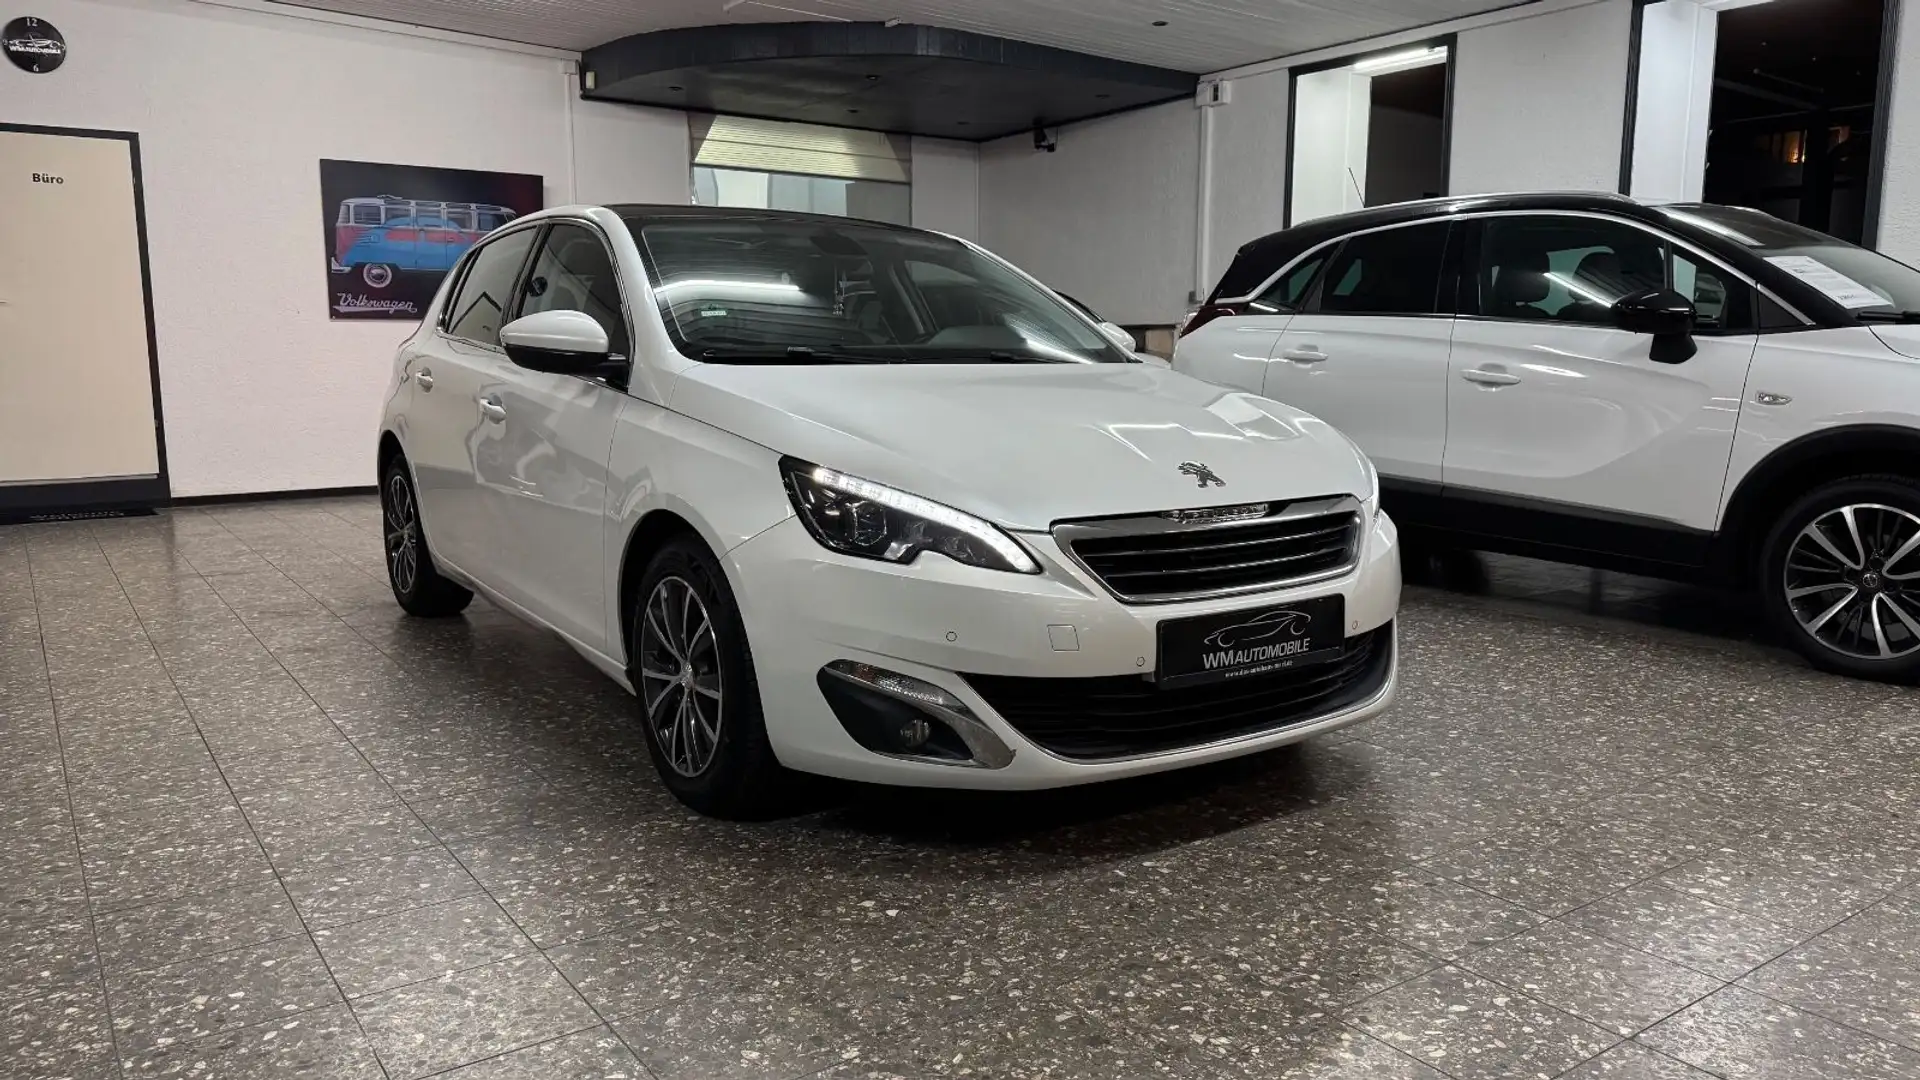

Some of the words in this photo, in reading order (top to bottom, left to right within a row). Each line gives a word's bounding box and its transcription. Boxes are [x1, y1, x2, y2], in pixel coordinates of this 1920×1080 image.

[26, 16, 39, 27] 12
[33, 63, 39, 72] 6
[32, 172, 64, 184] Büro
[335, 292, 417, 314] Volkswagen
